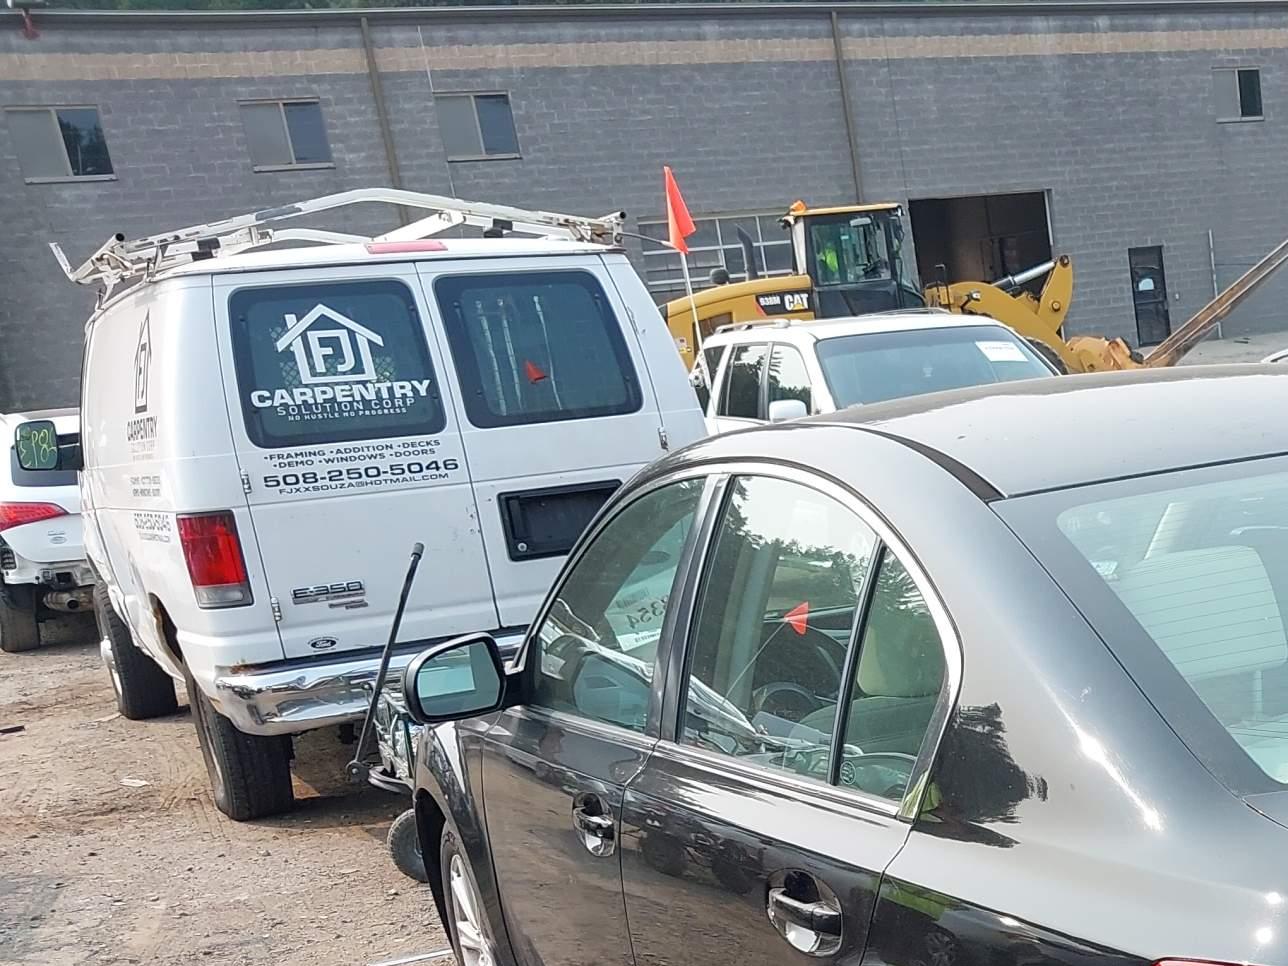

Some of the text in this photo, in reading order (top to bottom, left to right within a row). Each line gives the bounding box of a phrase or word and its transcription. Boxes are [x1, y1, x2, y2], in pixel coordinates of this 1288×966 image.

[783, 293, 809, 311] CAT
[250, 379, 431, 408] CARPENTRY
[276, 397, 416, 416] SOLUTION CORP
[304, 411, 340, 419] HUSTLE
[358, 407, 407, 416] PROGRESS
[263, 458, 459, 488] 508-250-5046
[278, 472, 450, 495] FJXXSOUZA@HOTMAIL.COM
